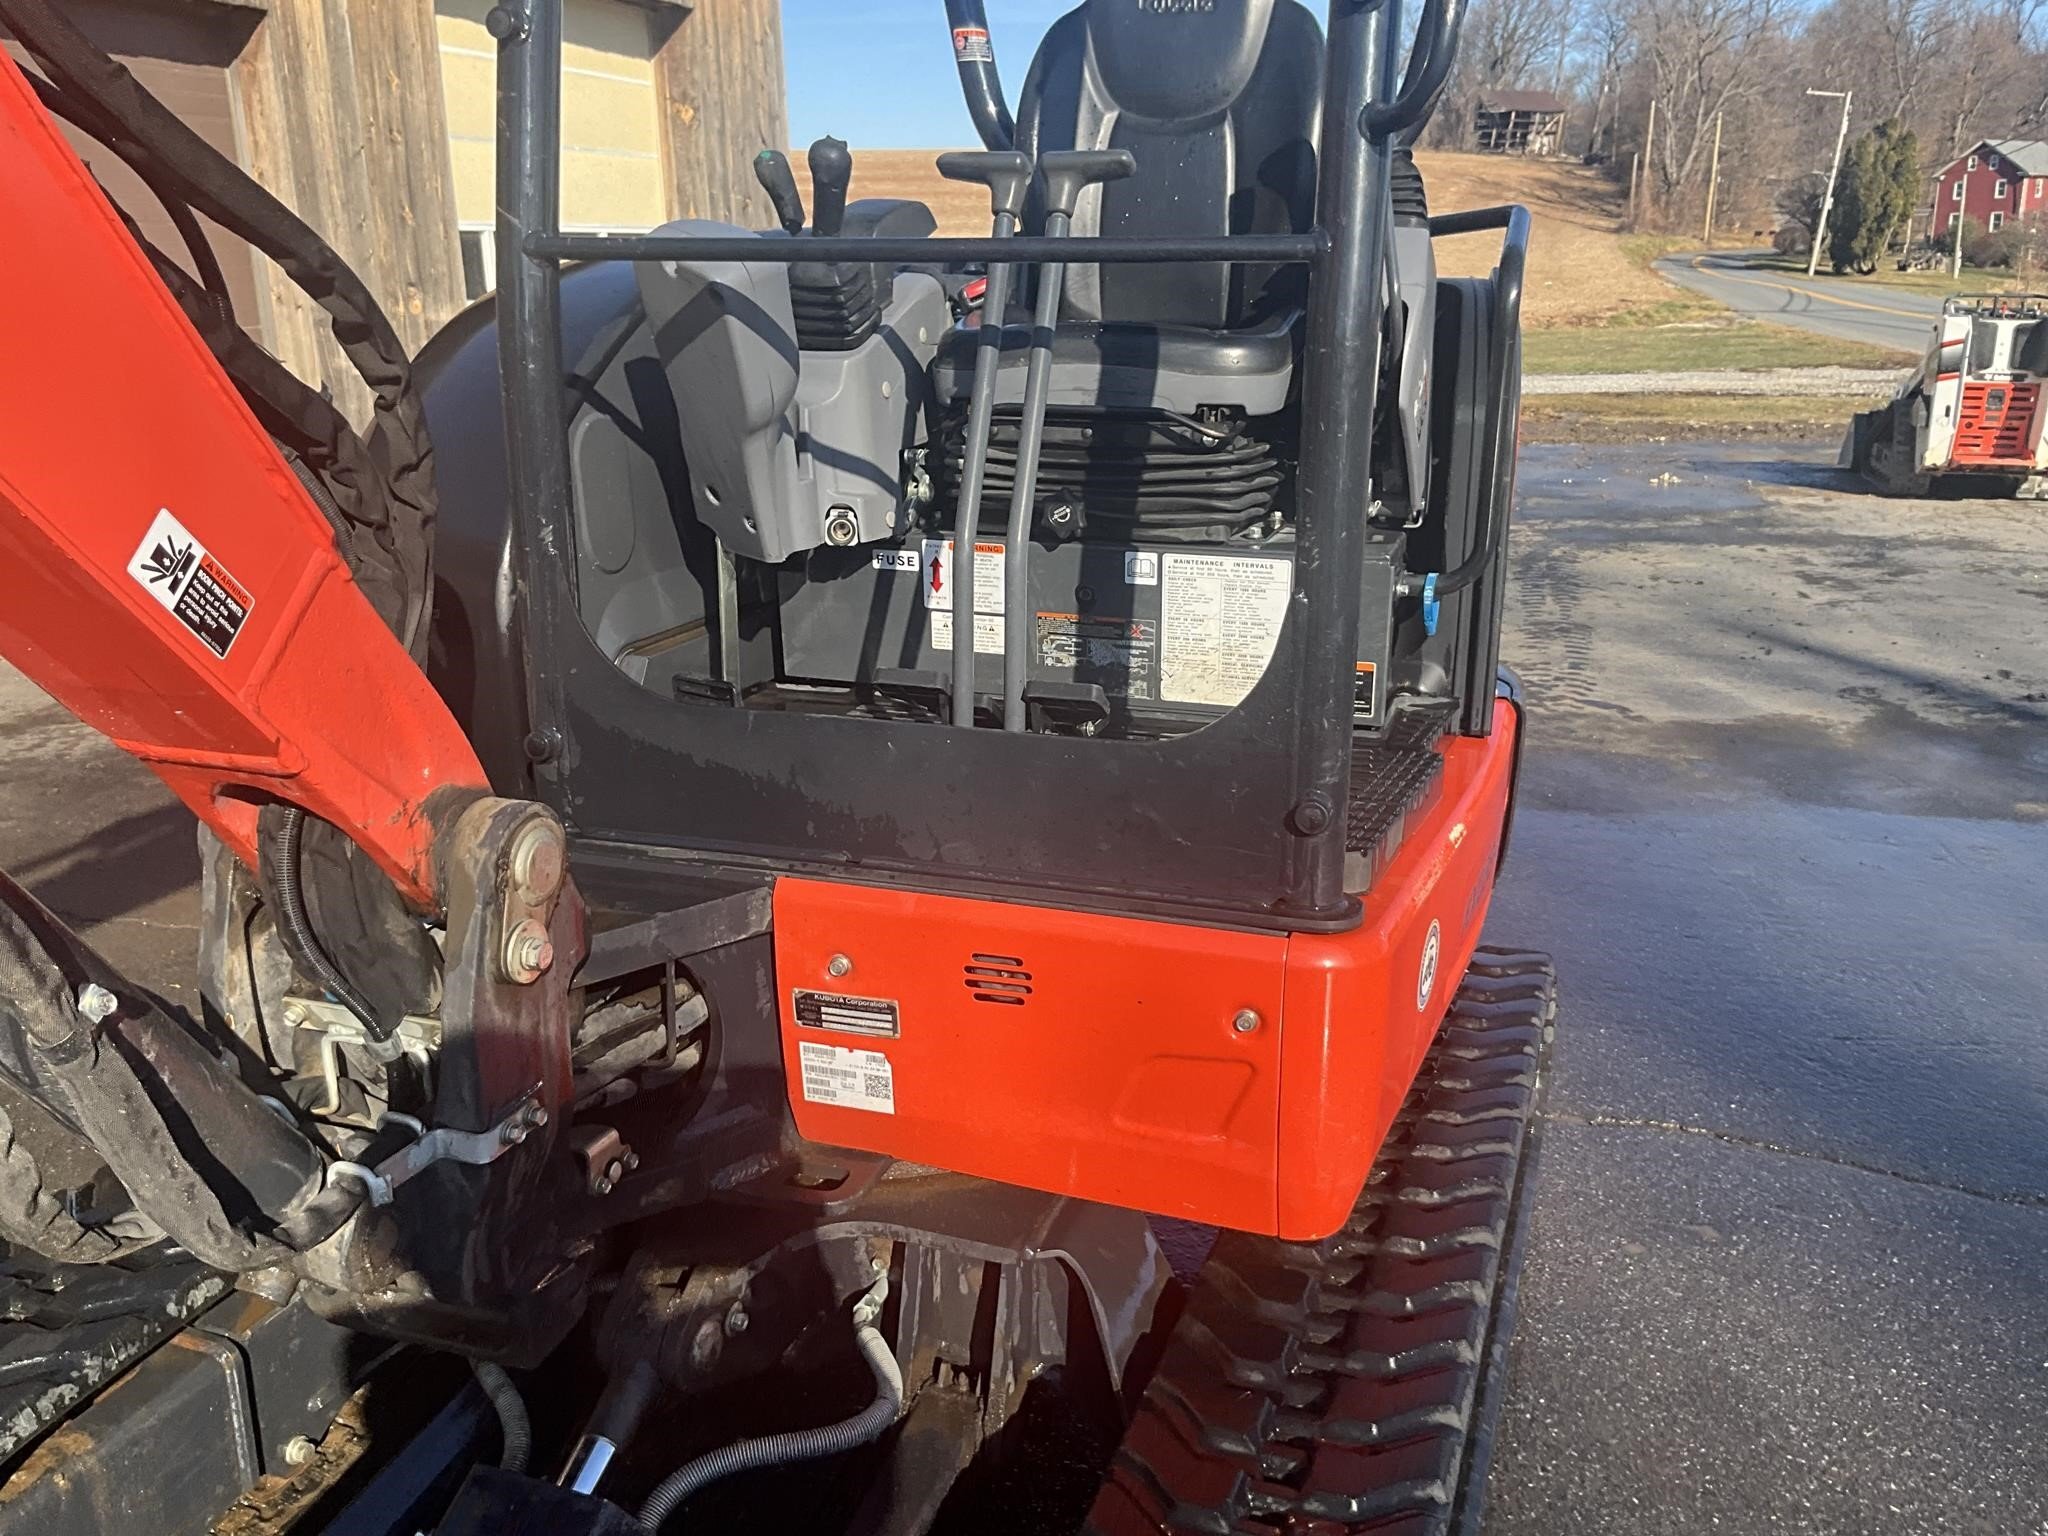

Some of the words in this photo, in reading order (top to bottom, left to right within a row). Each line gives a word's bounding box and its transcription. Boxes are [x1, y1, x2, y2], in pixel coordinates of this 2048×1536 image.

[876, 554, 916, 566] FUSE
[1173, 559, 1224, 567] MAINTENANCE
[1233, 562, 1274, 570] INTERVALS
[198, 569, 212, 586] BOOM
[193, 579, 205, 593] Keep
[206, 592, 214, 601] out
[215, 569, 248, 604] WARNING
[846, 998, 888, 1008] Corporation
